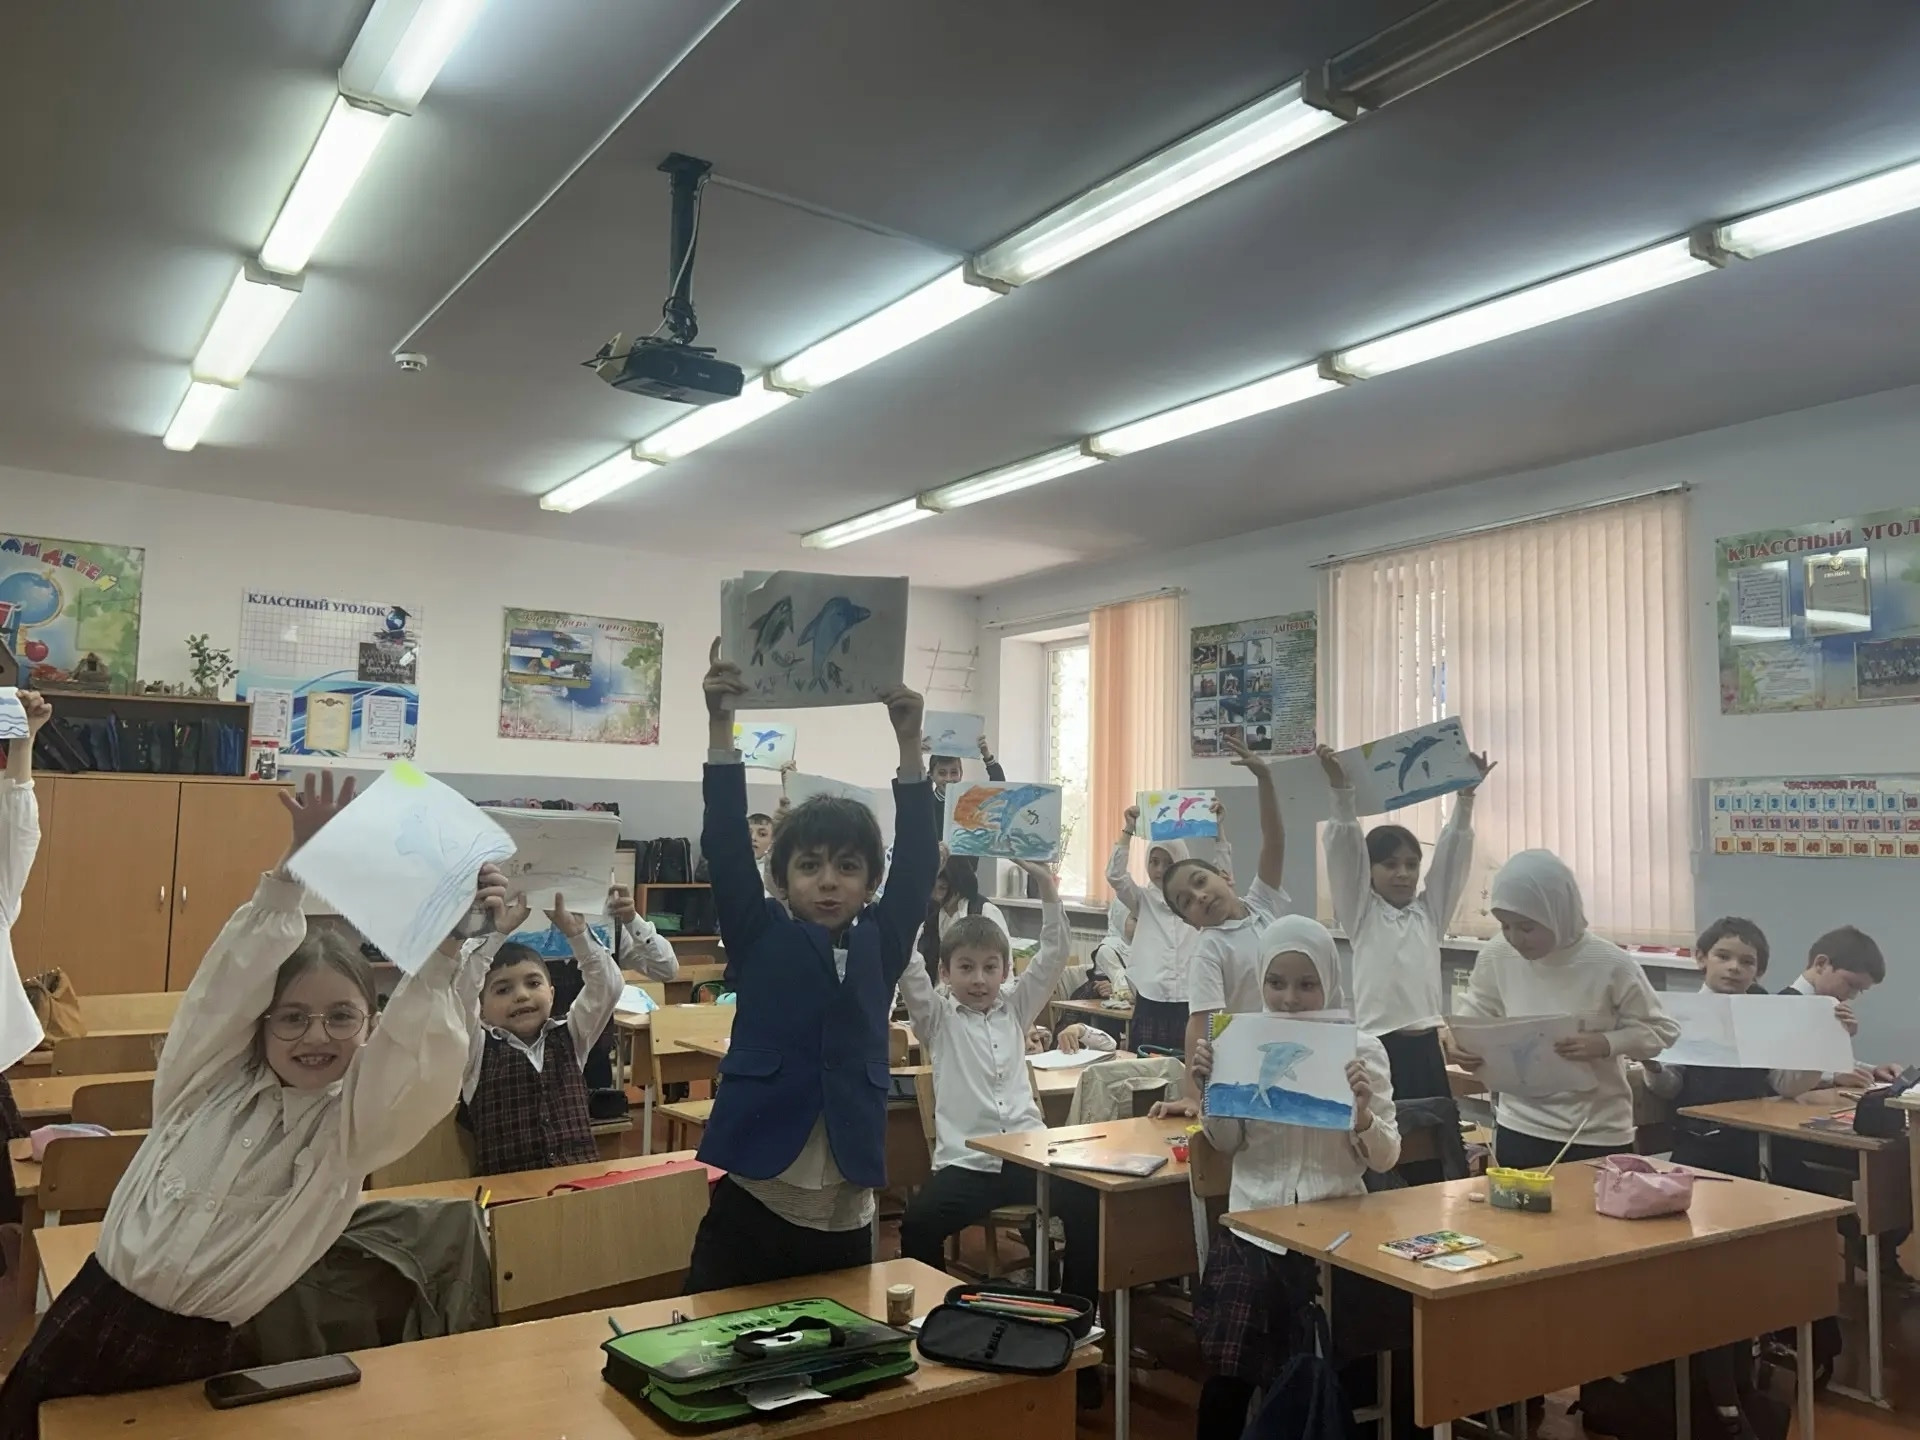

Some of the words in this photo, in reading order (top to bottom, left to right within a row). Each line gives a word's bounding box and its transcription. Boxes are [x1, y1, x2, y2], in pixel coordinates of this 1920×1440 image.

[1728, 528, 1852, 562] КЛАССНЫЙ
[248, 593, 329, 611] КЛАССНЫЙ
[333, 602, 386, 617] УГОЛОК
[1718, 798, 1725, 809] 0
[1736, 798, 1741, 809] 1
[1753, 798, 1761, 809] 2
[1771, 798, 1779, 809] 3
[1790, 798, 1797, 809] 4
[1809, 798, 1816, 809] 5
[1828, 798, 1835, 809] 6
[1847, 798, 1856, 809] 7
[1867, 798, 1874, 809] 8
[1887, 798, 1895, 809] 9
